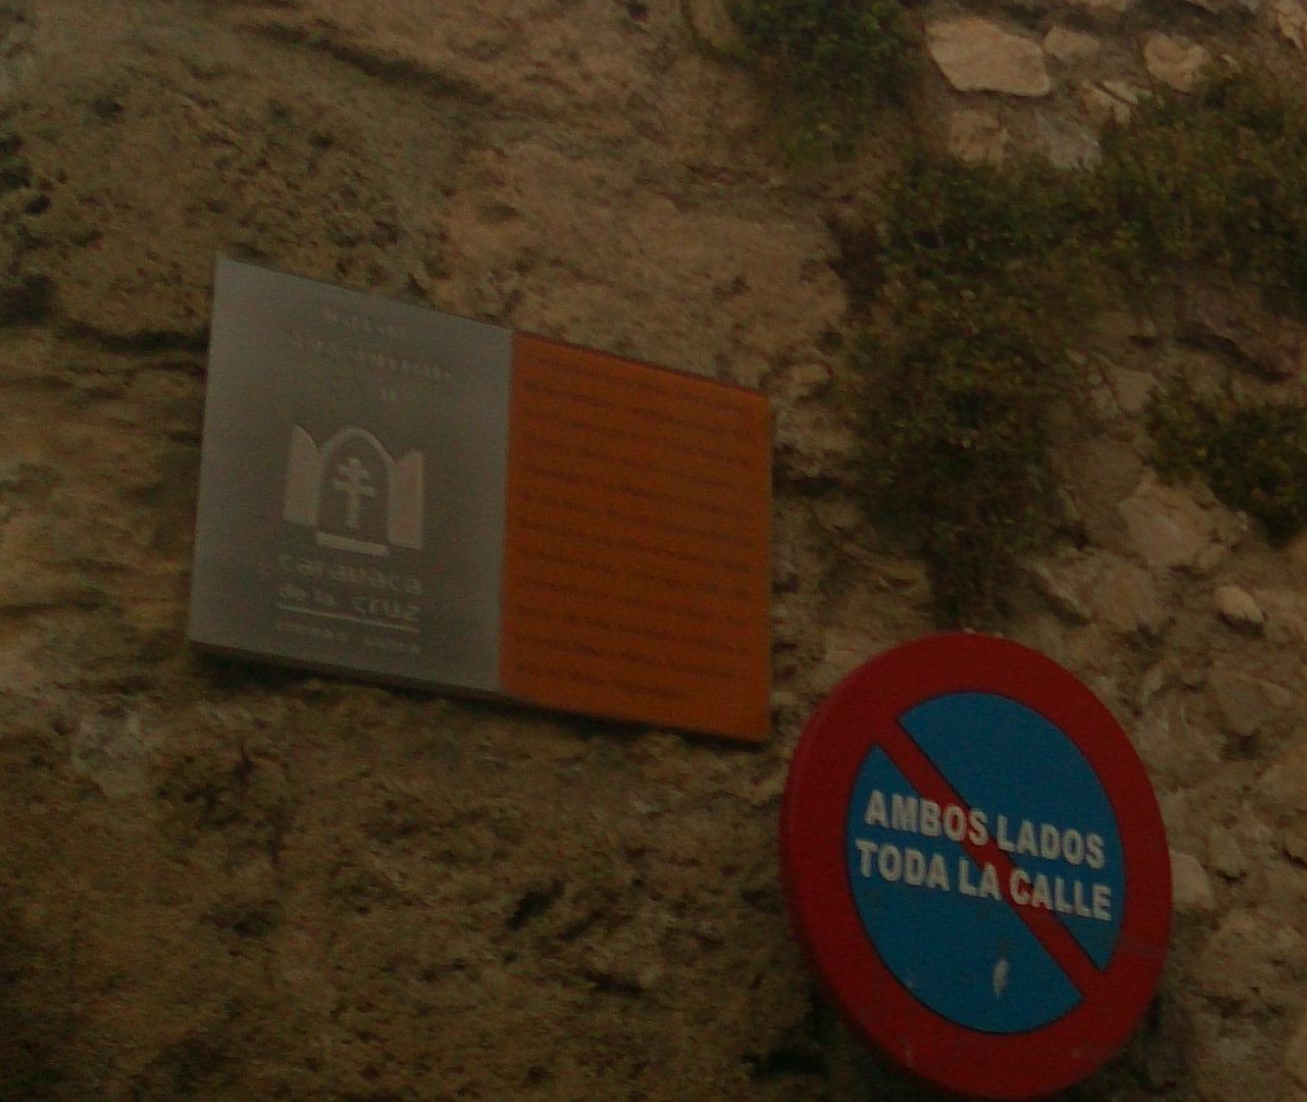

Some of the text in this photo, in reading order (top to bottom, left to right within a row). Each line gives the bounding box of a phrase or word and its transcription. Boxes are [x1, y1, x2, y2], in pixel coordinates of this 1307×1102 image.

[865, 789, 1105, 869] AMBOS LADOS
[856, 837, 1112, 922] TODA LA CALLE
